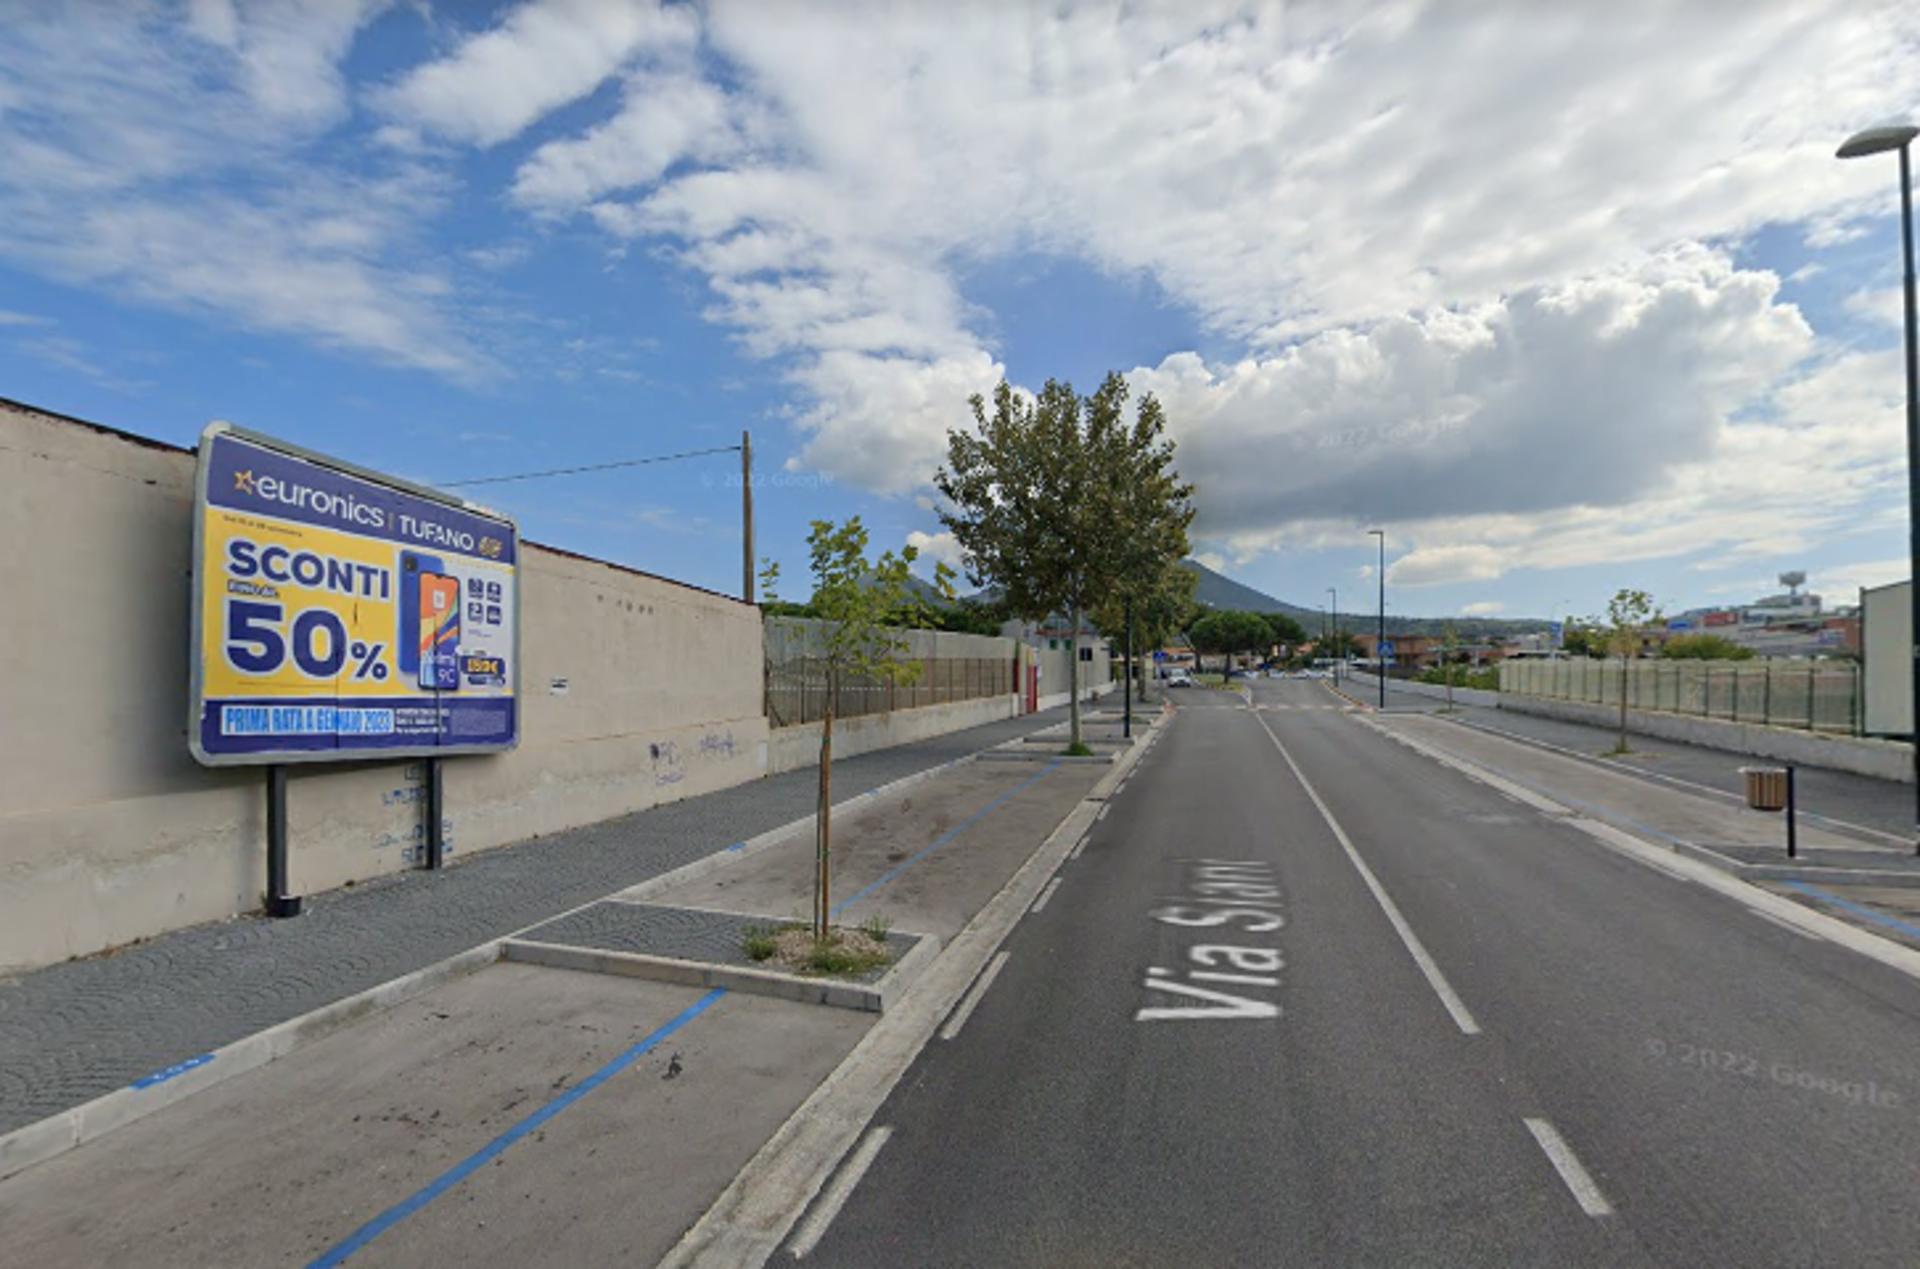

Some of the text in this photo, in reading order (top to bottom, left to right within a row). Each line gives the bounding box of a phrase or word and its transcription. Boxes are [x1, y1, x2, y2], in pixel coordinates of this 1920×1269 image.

[256, 475, 385, 528] euronics
[398, 514, 474, 551] TUFANO
[228, 539, 390, 599] SCONTI
[226, 599, 389, 681] 50%
[226, 708, 270, 733] PRIMA
[272, 708, 303, 733] RATA
